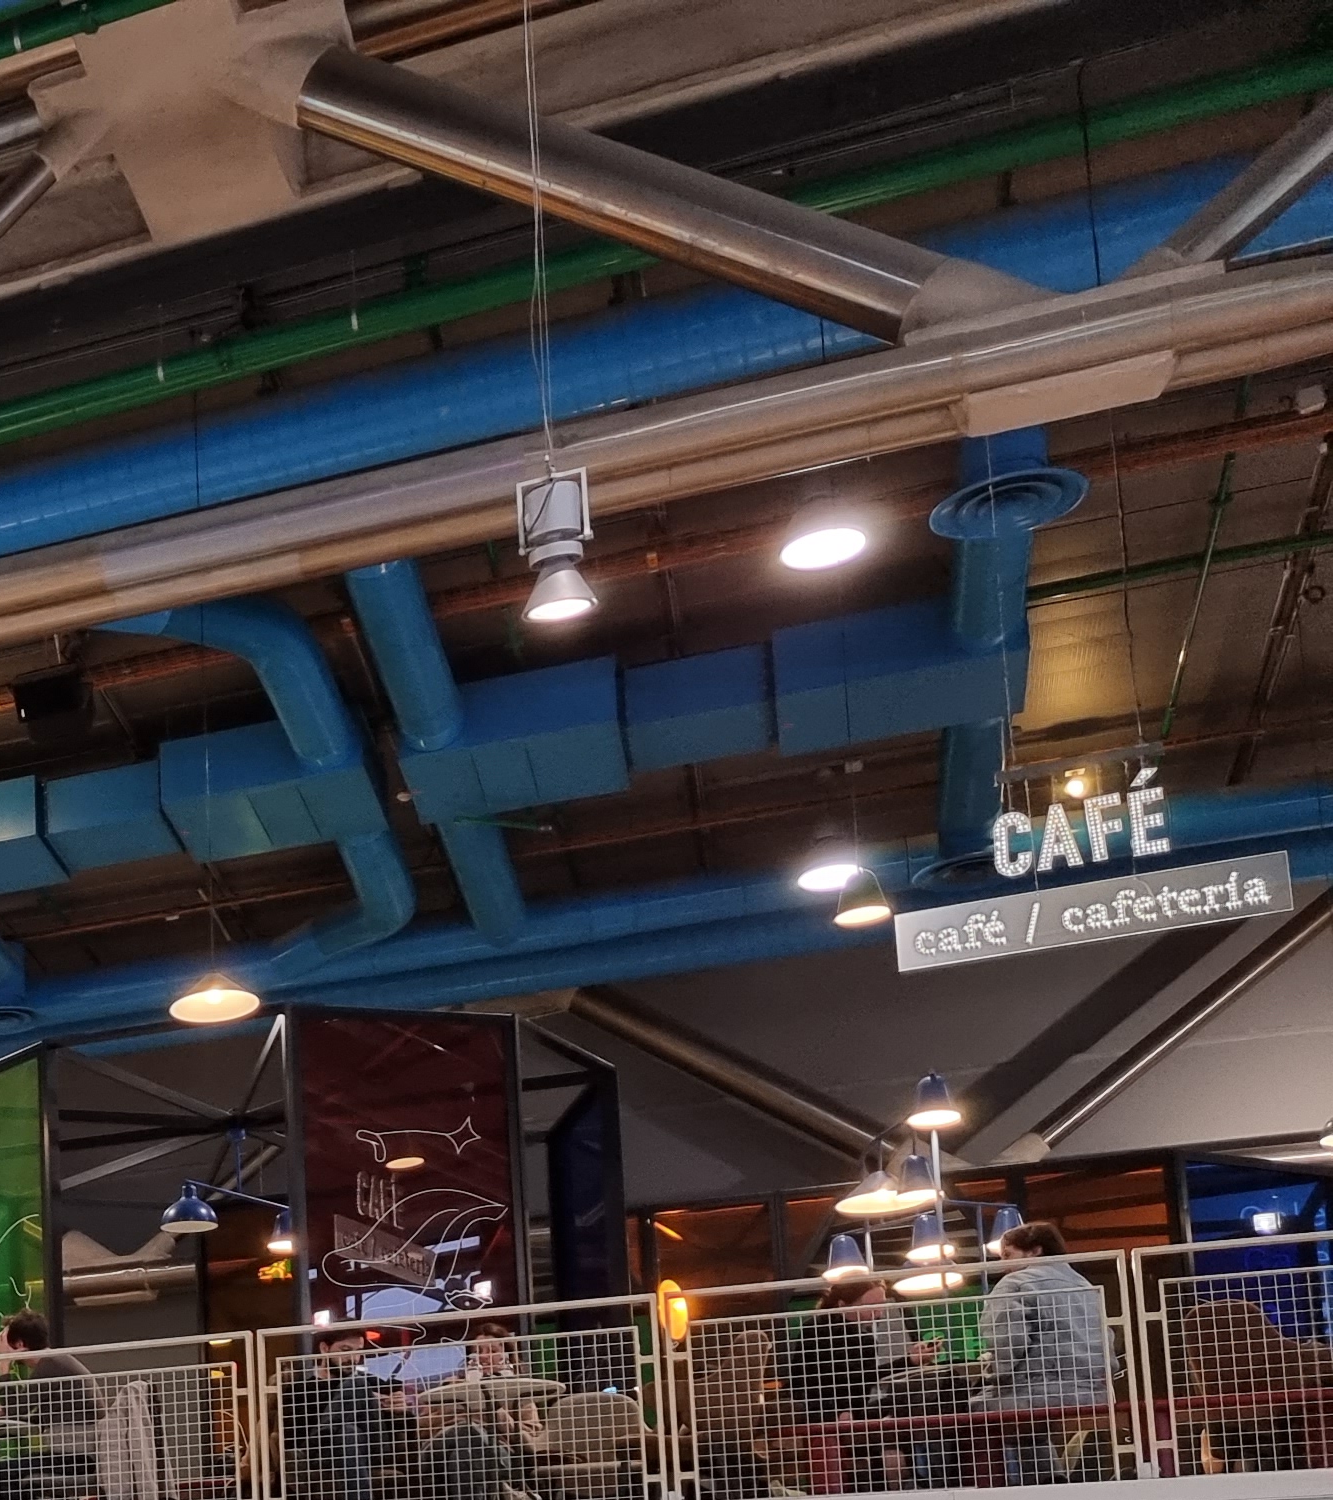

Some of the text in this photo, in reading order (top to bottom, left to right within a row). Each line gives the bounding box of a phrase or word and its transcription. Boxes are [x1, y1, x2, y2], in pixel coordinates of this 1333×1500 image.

[992, 767, 1171, 878] CAFÉ
[914, 909, 1008, 956] café
[1061, 870, 1273, 934] cafetería
